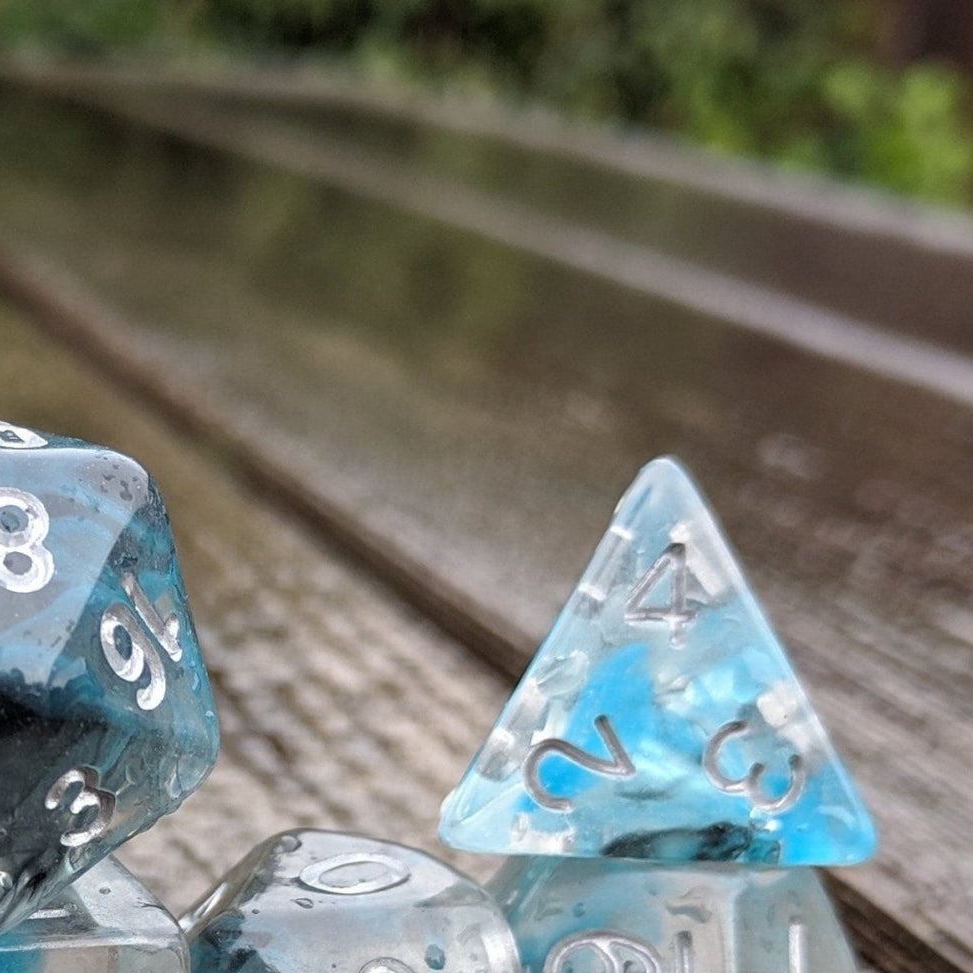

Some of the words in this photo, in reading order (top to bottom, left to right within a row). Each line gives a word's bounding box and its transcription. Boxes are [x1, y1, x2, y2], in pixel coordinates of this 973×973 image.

[623, 541, 697, 648] 4
[44, 764, 117, 847] 3
[523, 713, 636, 812] 2
[702, 719, 806, 815] 3
